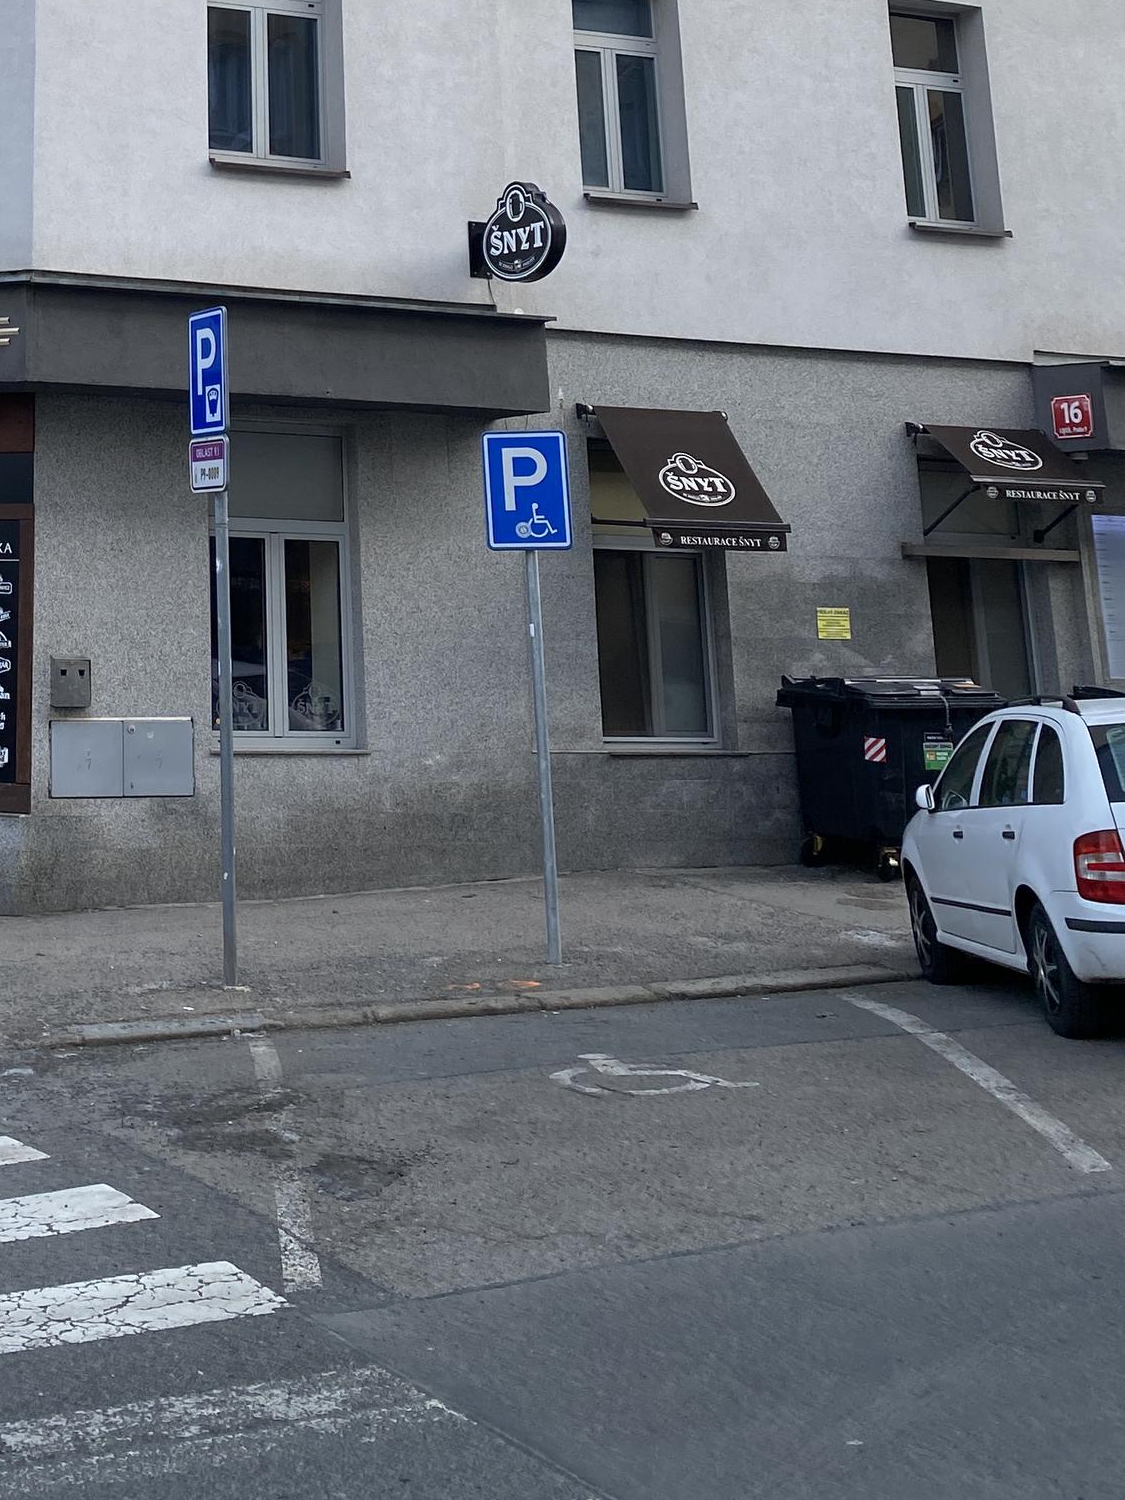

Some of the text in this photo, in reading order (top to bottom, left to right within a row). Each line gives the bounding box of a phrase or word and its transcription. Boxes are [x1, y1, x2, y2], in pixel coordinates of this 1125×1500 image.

[489, 221, 545, 256] ŠNYT
[196, 327, 217, 396] P
[1060, 401, 1083, 424] 16
[975, 443, 1035, 462] ŠNYT
[501, 446, 548, 512] P
[665, 471, 728, 493] ŠNYT
[1005, 489, 1081, 500] RESTAURACE ŠNYT
[680, 535, 762, 547] RESTAURACE ŠNYT
